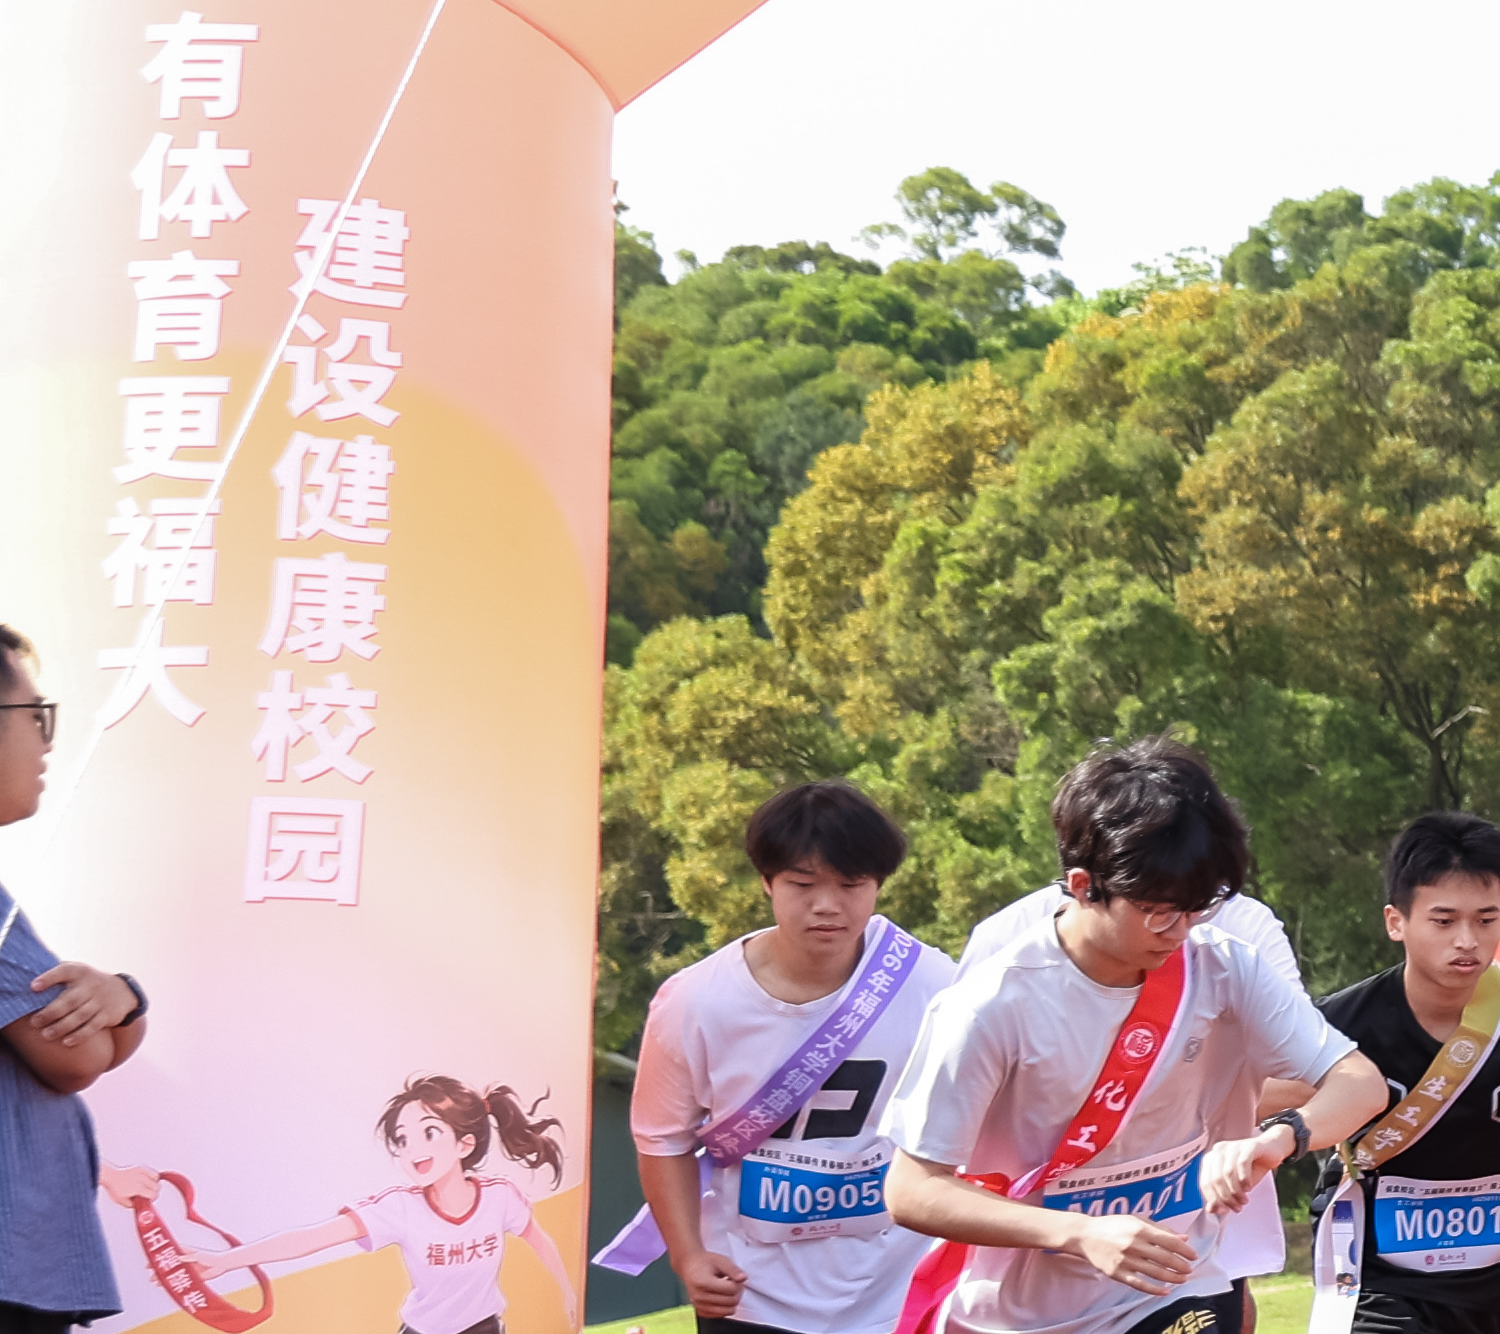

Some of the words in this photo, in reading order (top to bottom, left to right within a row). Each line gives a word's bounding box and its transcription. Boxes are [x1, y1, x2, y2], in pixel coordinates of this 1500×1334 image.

[97, 10, 259, 730] 有体育更福大
[245, 196, 410, 907] 建设健康校园
[426, 1233, 498, 1266] 福州大学
[758, 1176, 882, 1214] M0905
